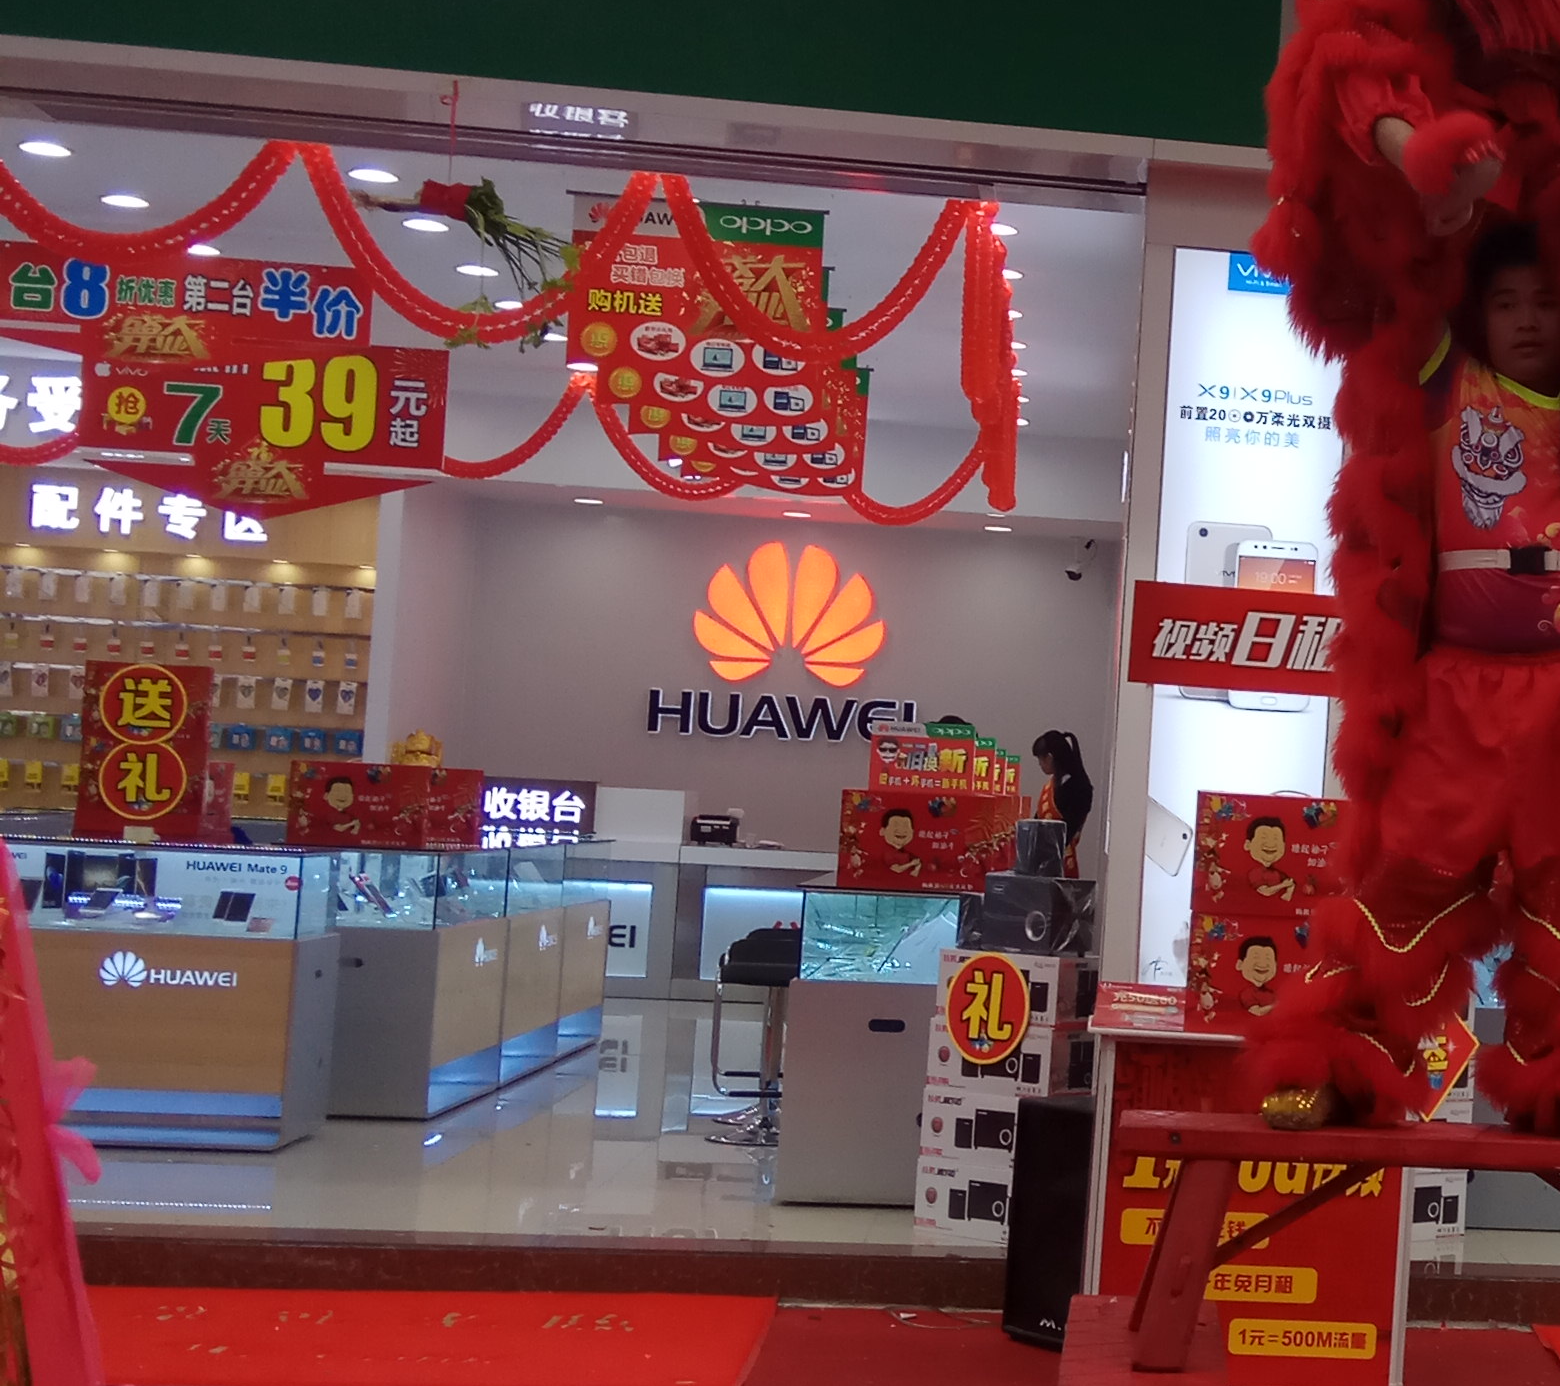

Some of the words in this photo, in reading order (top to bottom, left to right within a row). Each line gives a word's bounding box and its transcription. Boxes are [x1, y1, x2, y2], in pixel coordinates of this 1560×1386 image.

[587, 289, 663, 317] 购机送
[115, 392, 142, 416] 抢
[1204, 426, 1301, 449] 照亮你的美
[484, 786, 586, 824] 收银台
[186, 860, 242, 873] HUAWEI
[247, 863, 278, 876] Mate
[279, 864, 288, 876] 9
[150, 968, 238, 988] HUAWEI
[962, 969, 1013, 1042] 礼
[1205, 1272, 1294, 1295] 年免月租
[1238, 1328, 1368, 1351] 1元=500M流量
